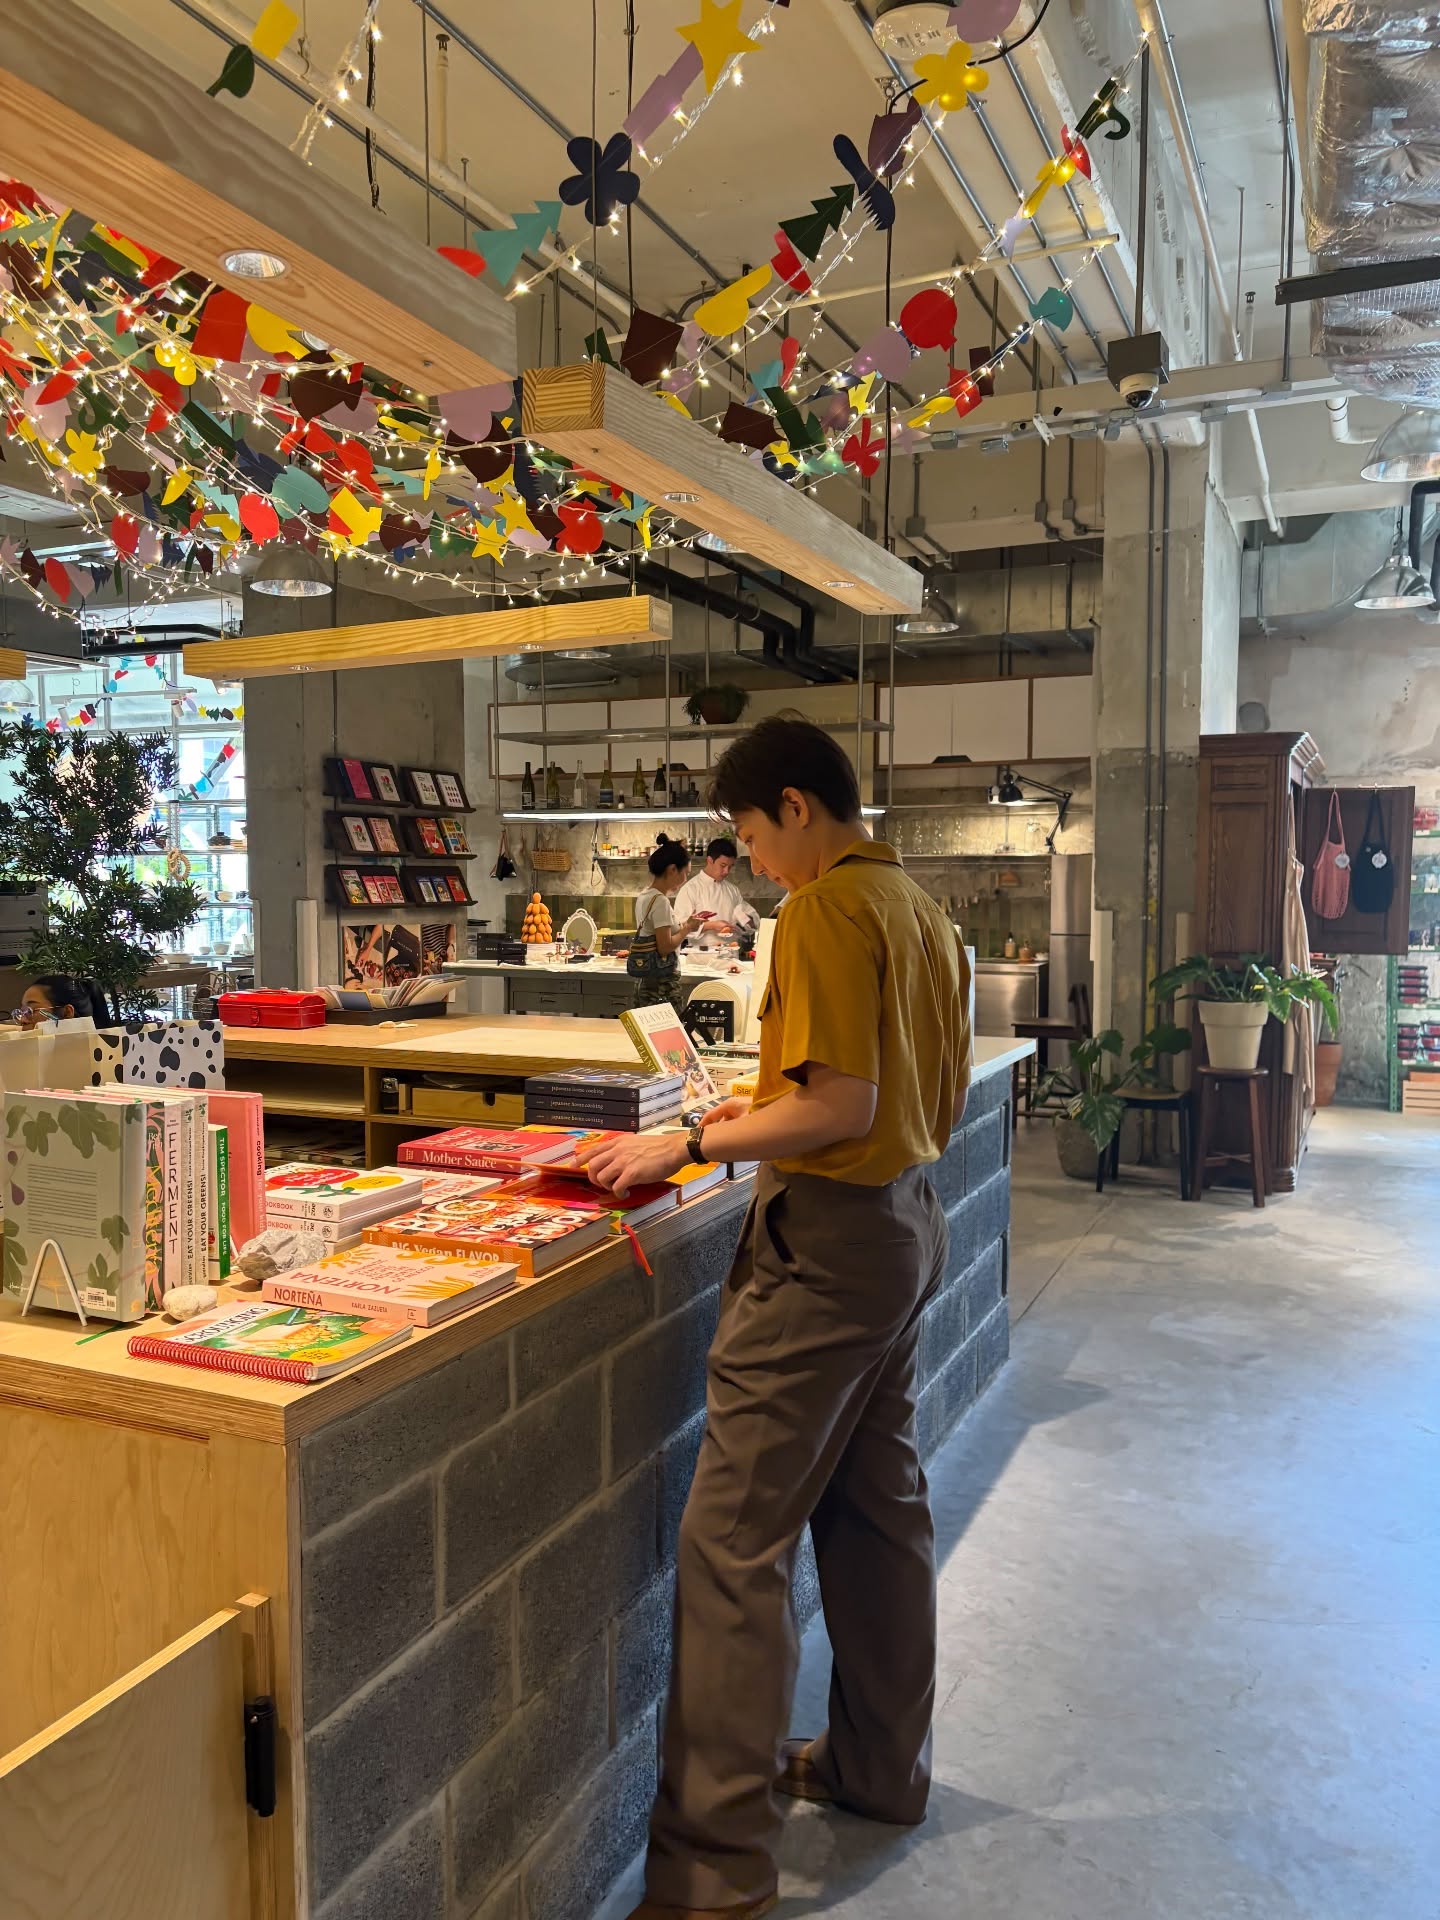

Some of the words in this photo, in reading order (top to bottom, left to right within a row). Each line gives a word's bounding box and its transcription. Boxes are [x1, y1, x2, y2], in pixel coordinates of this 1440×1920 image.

[256, 1140, 264, 1176] cooking
[422, 1151, 463, 1165] Mother
[464, 1154, 497, 1168] Sauce
[167, 1132, 179, 1254] FERMENT
[256, 1192, 264, 1213] your
[388, 1200, 497, 1233] BIG
[451, 1206, 544, 1236] Vegan
[506, 1210, 594, 1244] FLAVOR
[391, 1242, 410, 1251] BIG
[413, 1245, 452, 1257] Vegan
[456, 1249, 499, 1262] FLAVOR
[289, 1271, 401, 1295] NORTEÑA
[274, 1287, 323, 1307] NORTEÑA
[351, 1302, 366, 1310] KARLA
